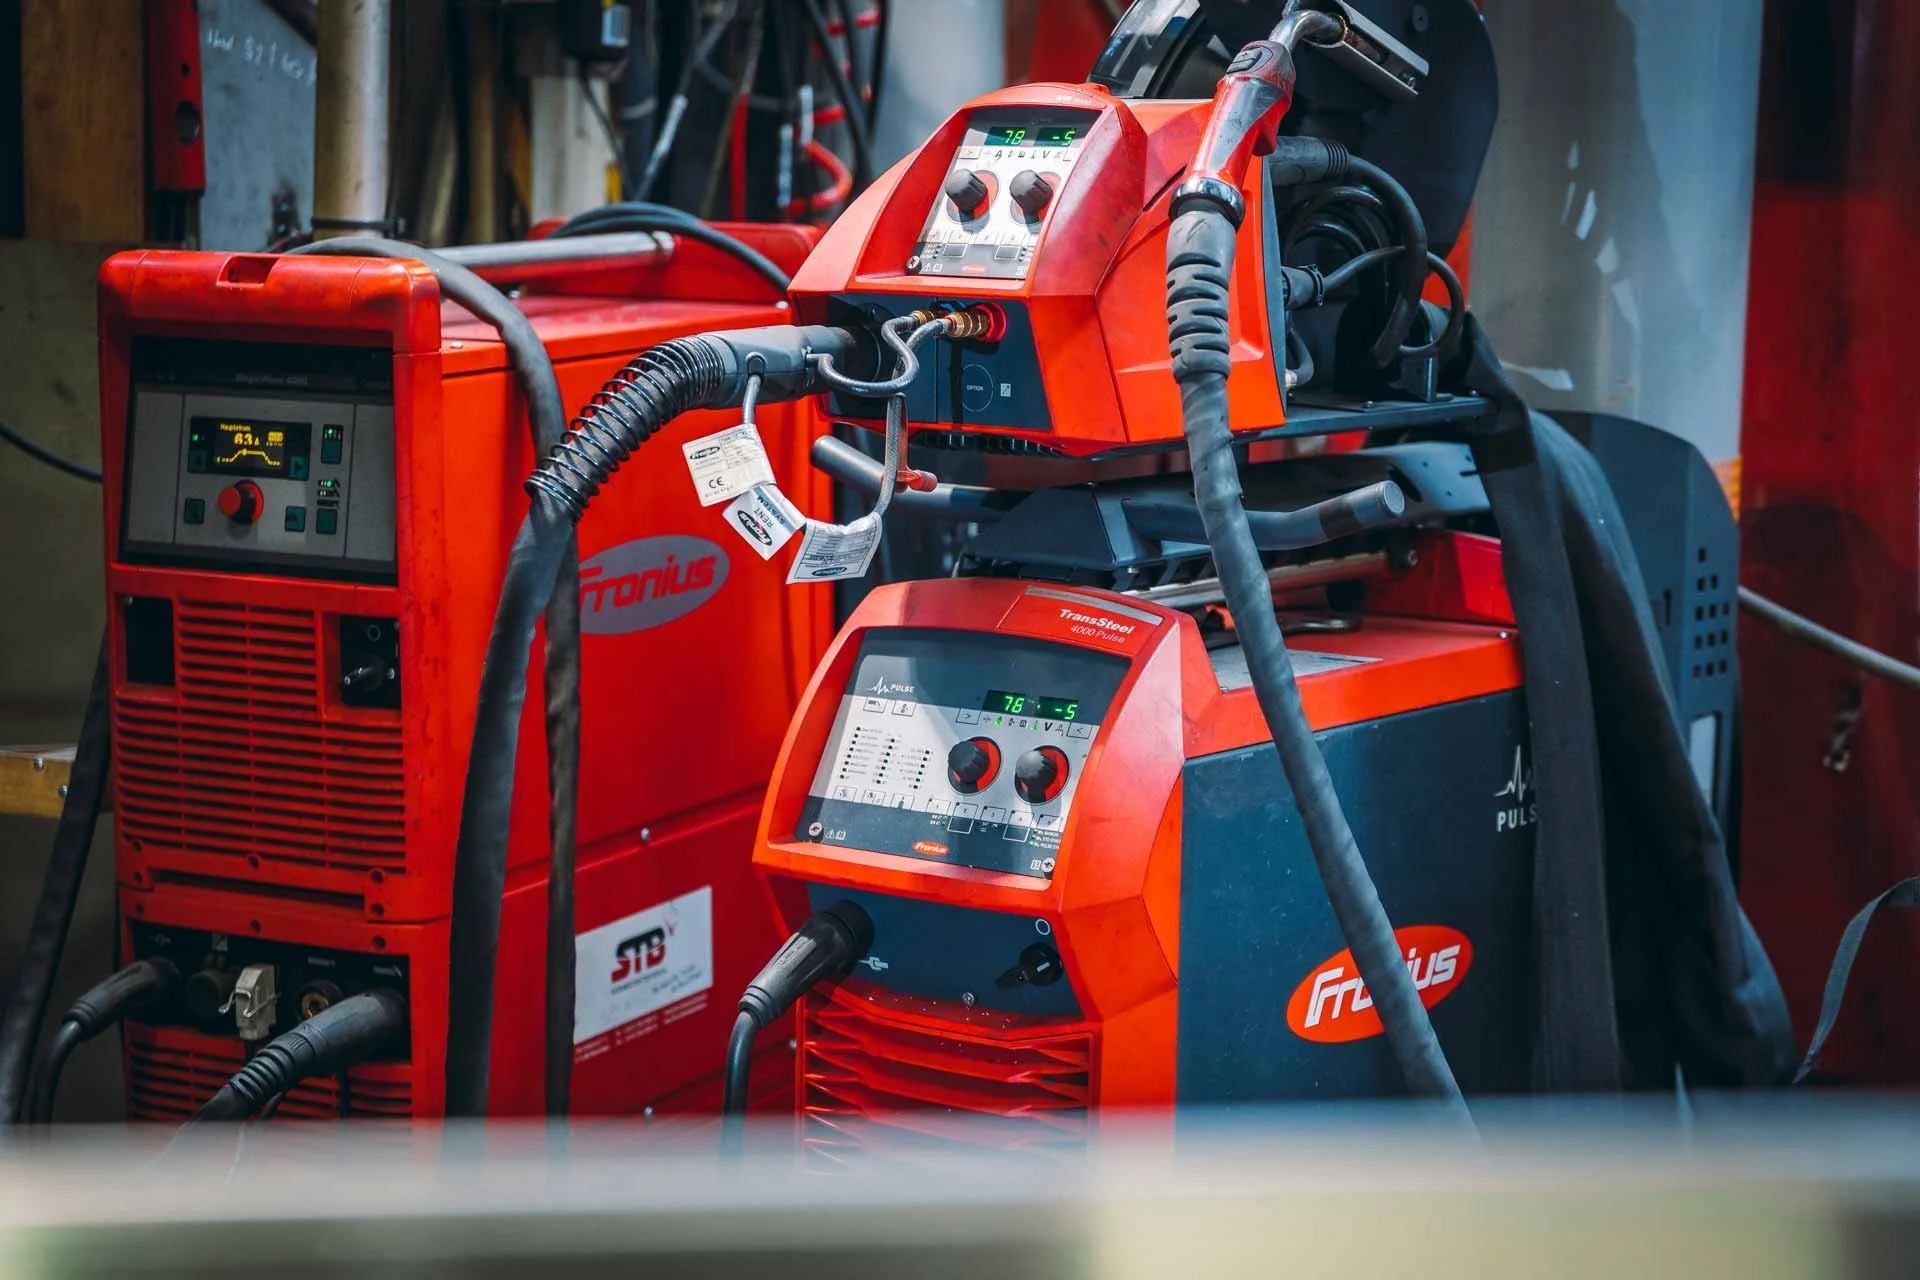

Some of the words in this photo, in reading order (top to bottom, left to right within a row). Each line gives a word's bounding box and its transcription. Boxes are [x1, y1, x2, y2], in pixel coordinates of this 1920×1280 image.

[1004, 130, 1026, 145] 78
[753, 507, 774, 528] RENT
[757, 495, 785, 525] SYSTEM
[1060, 609, 1135, 634] TransSteel
[1071, 625, 1096, 636] 4000
[1096, 630, 1126, 643] Pulse
[890, 683, 915, 693] PULSE
[1496, 803, 1538, 833] PULS
[1304, 945, 1461, 1029] Froius
